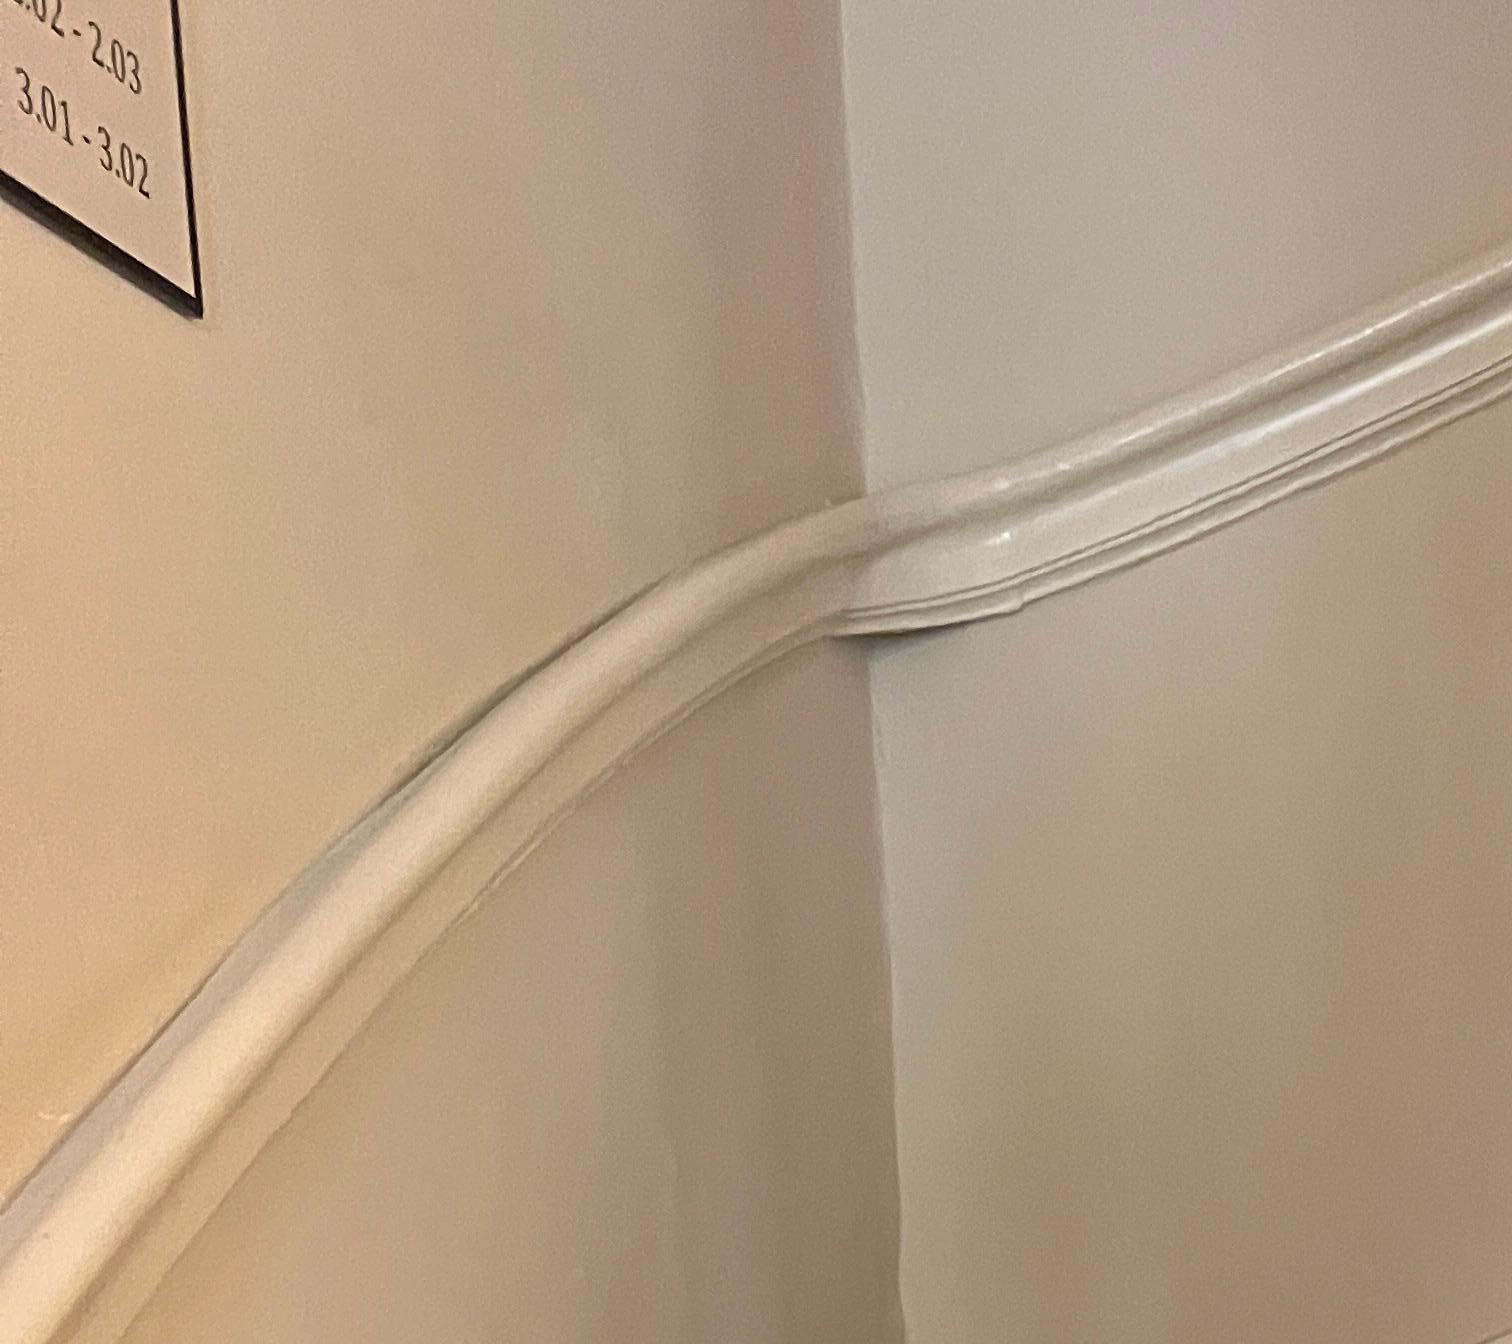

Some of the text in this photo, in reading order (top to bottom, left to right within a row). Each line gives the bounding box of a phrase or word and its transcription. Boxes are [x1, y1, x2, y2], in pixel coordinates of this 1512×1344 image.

[13, 0, 65, 38] .02
[88, 21, 142, 95] 2.03
[15, 67, 74, 147] 3.01
[97, 125, 150, 200] 3.02
